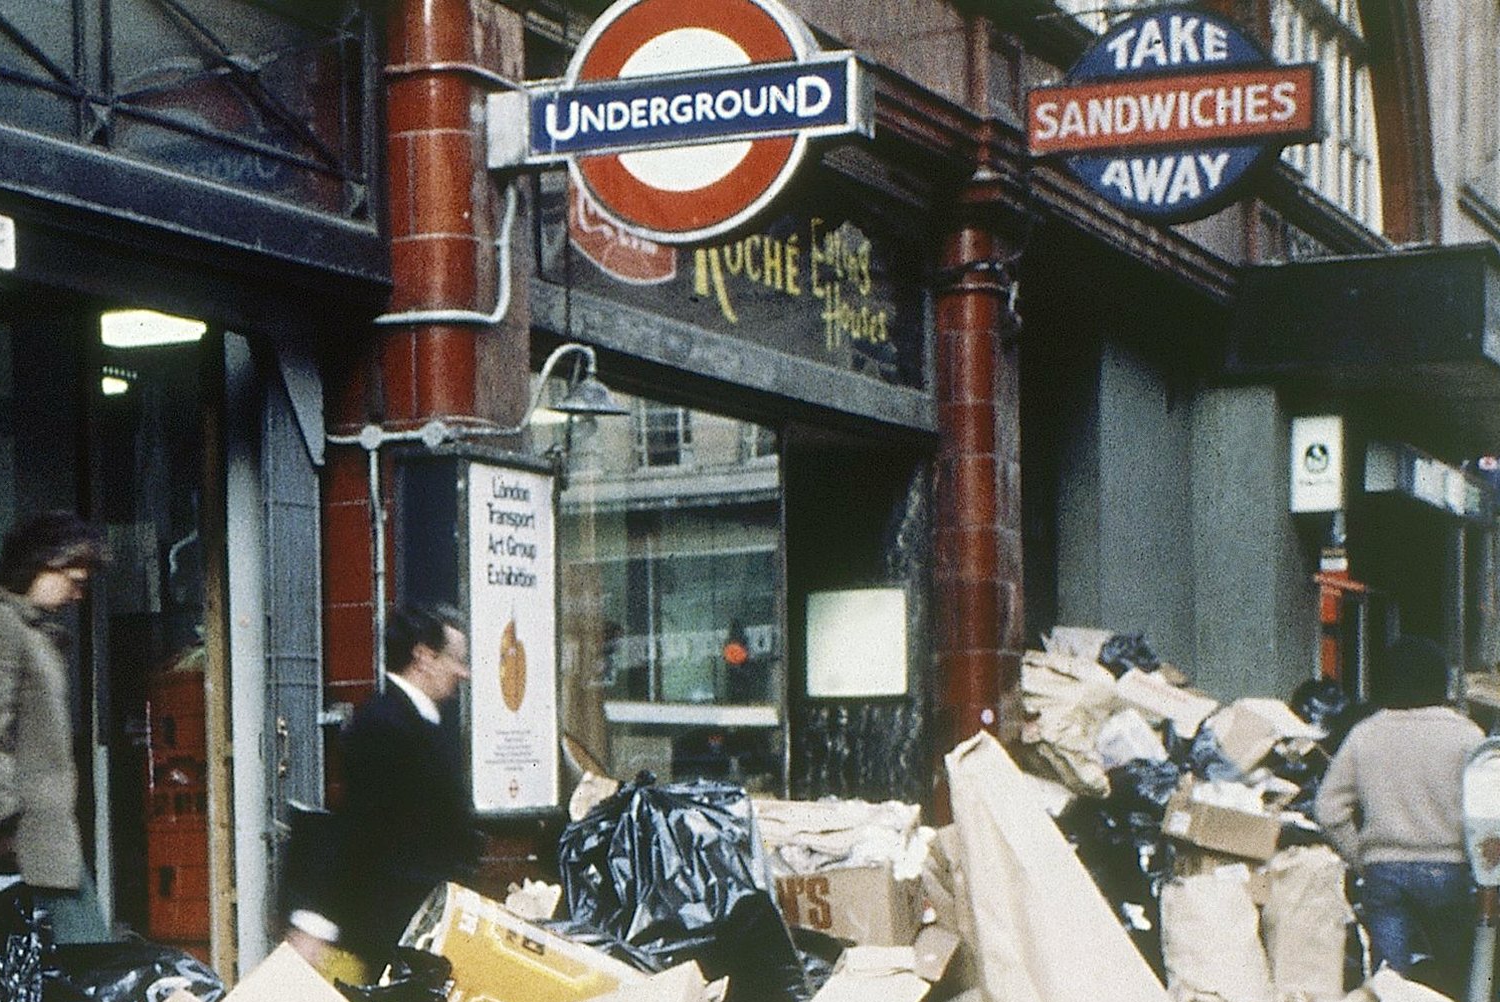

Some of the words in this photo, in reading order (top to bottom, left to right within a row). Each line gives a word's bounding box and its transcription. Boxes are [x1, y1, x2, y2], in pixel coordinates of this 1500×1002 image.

[1106, 15, 1228, 70] TAKE
[545, 75, 831, 141] UNDERGROUND
[1035, 82, 1297, 141] SANDWICHES
[1101, 153, 1230, 205] AWAY
[492, 475, 531, 501] London
[486, 501, 536, 532] Transport
[488, 533, 504, 556] Art
[506, 535, 537, 562] Group
[487, 562, 537, 588] Exhibition
